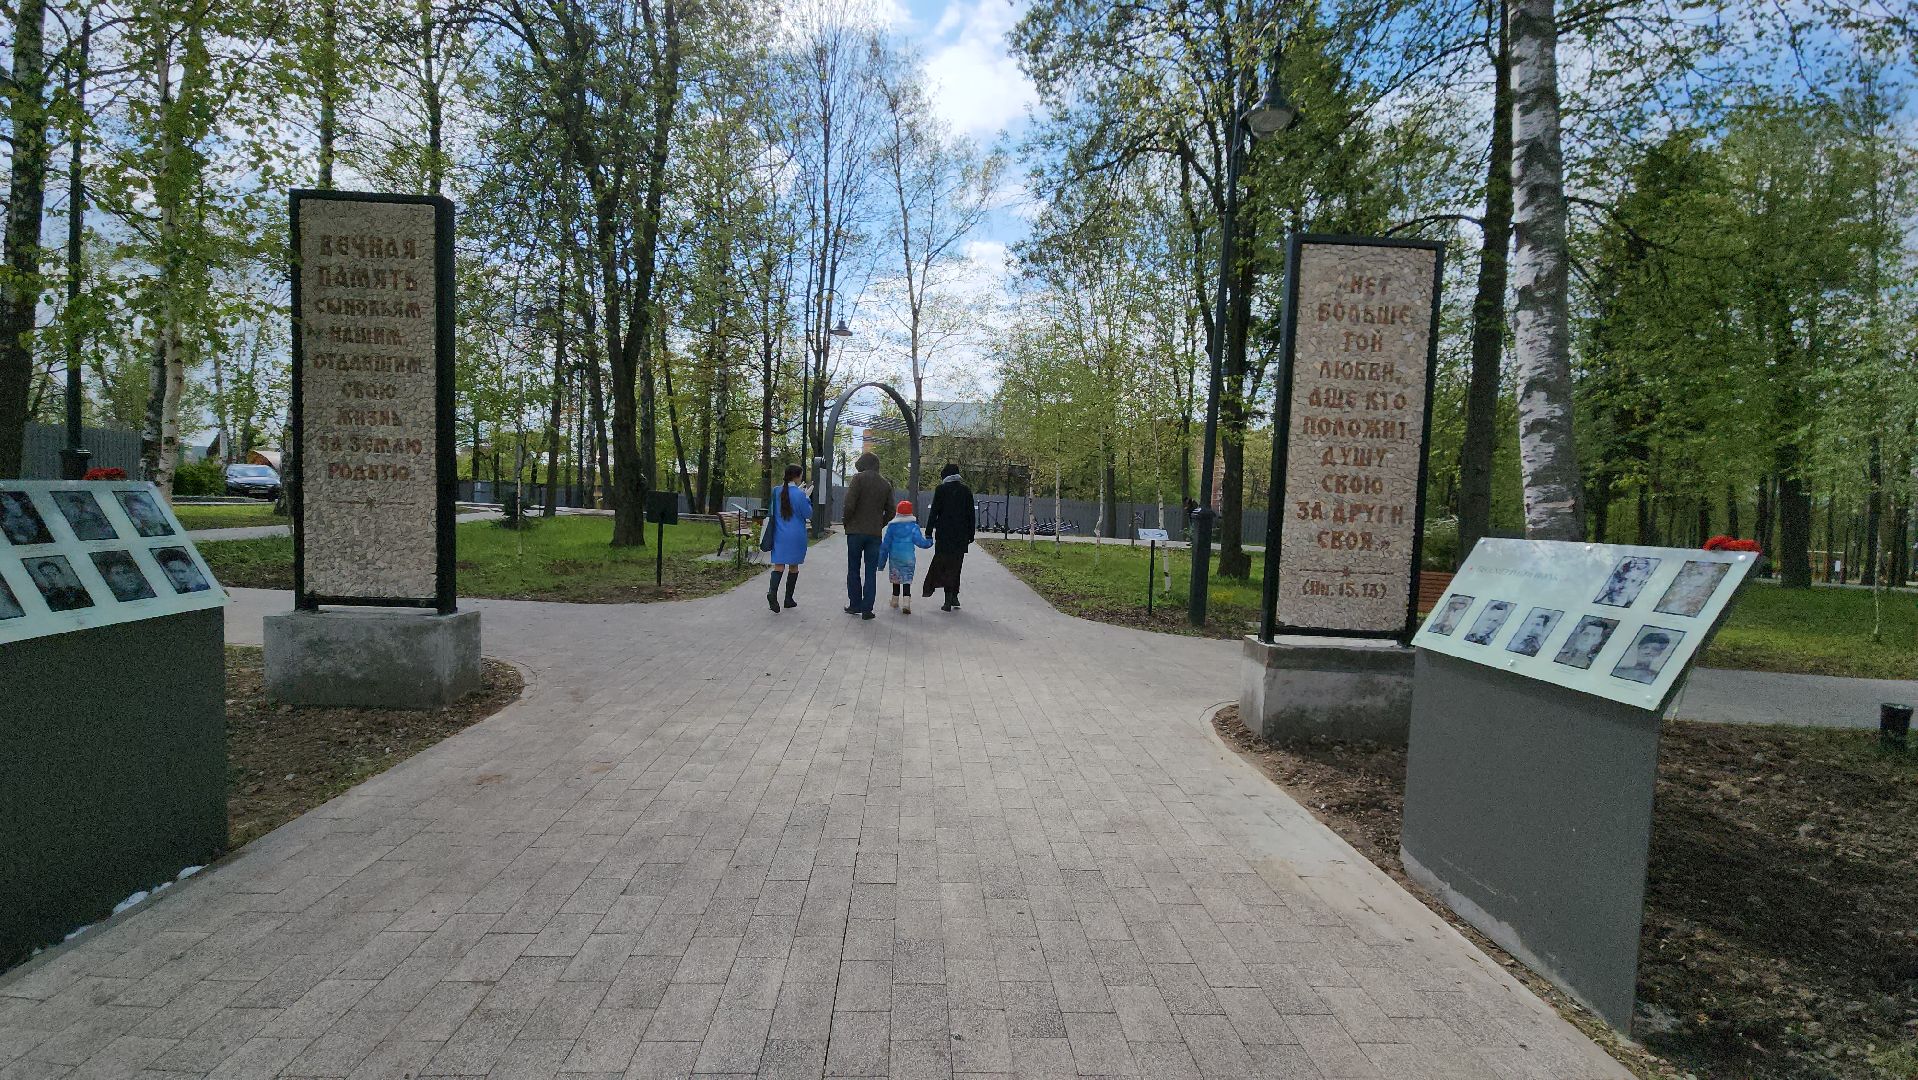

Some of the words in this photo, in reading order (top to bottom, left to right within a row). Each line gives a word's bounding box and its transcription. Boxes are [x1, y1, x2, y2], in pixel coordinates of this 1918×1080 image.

[319, 233, 417, 260] ВЕЧНАЯ
[318, 264, 419, 292] ПАМЯТЬ
[1317, 301, 1412, 327] БОЛЬШЕ
[1342, 328, 1384, 353] ТОЙ
[1365, 387, 1408, 411] КТО
[1302, 415, 1408, 440] ПОЛОЖИТ
[1320, 445, 1388, 468] ДУШУ
[1321, 473, 1384, 496] СВОЮ
[1296, 501, 1323, 521] ЗА
[1332, 502, 1404, 526] ДРУГИ
